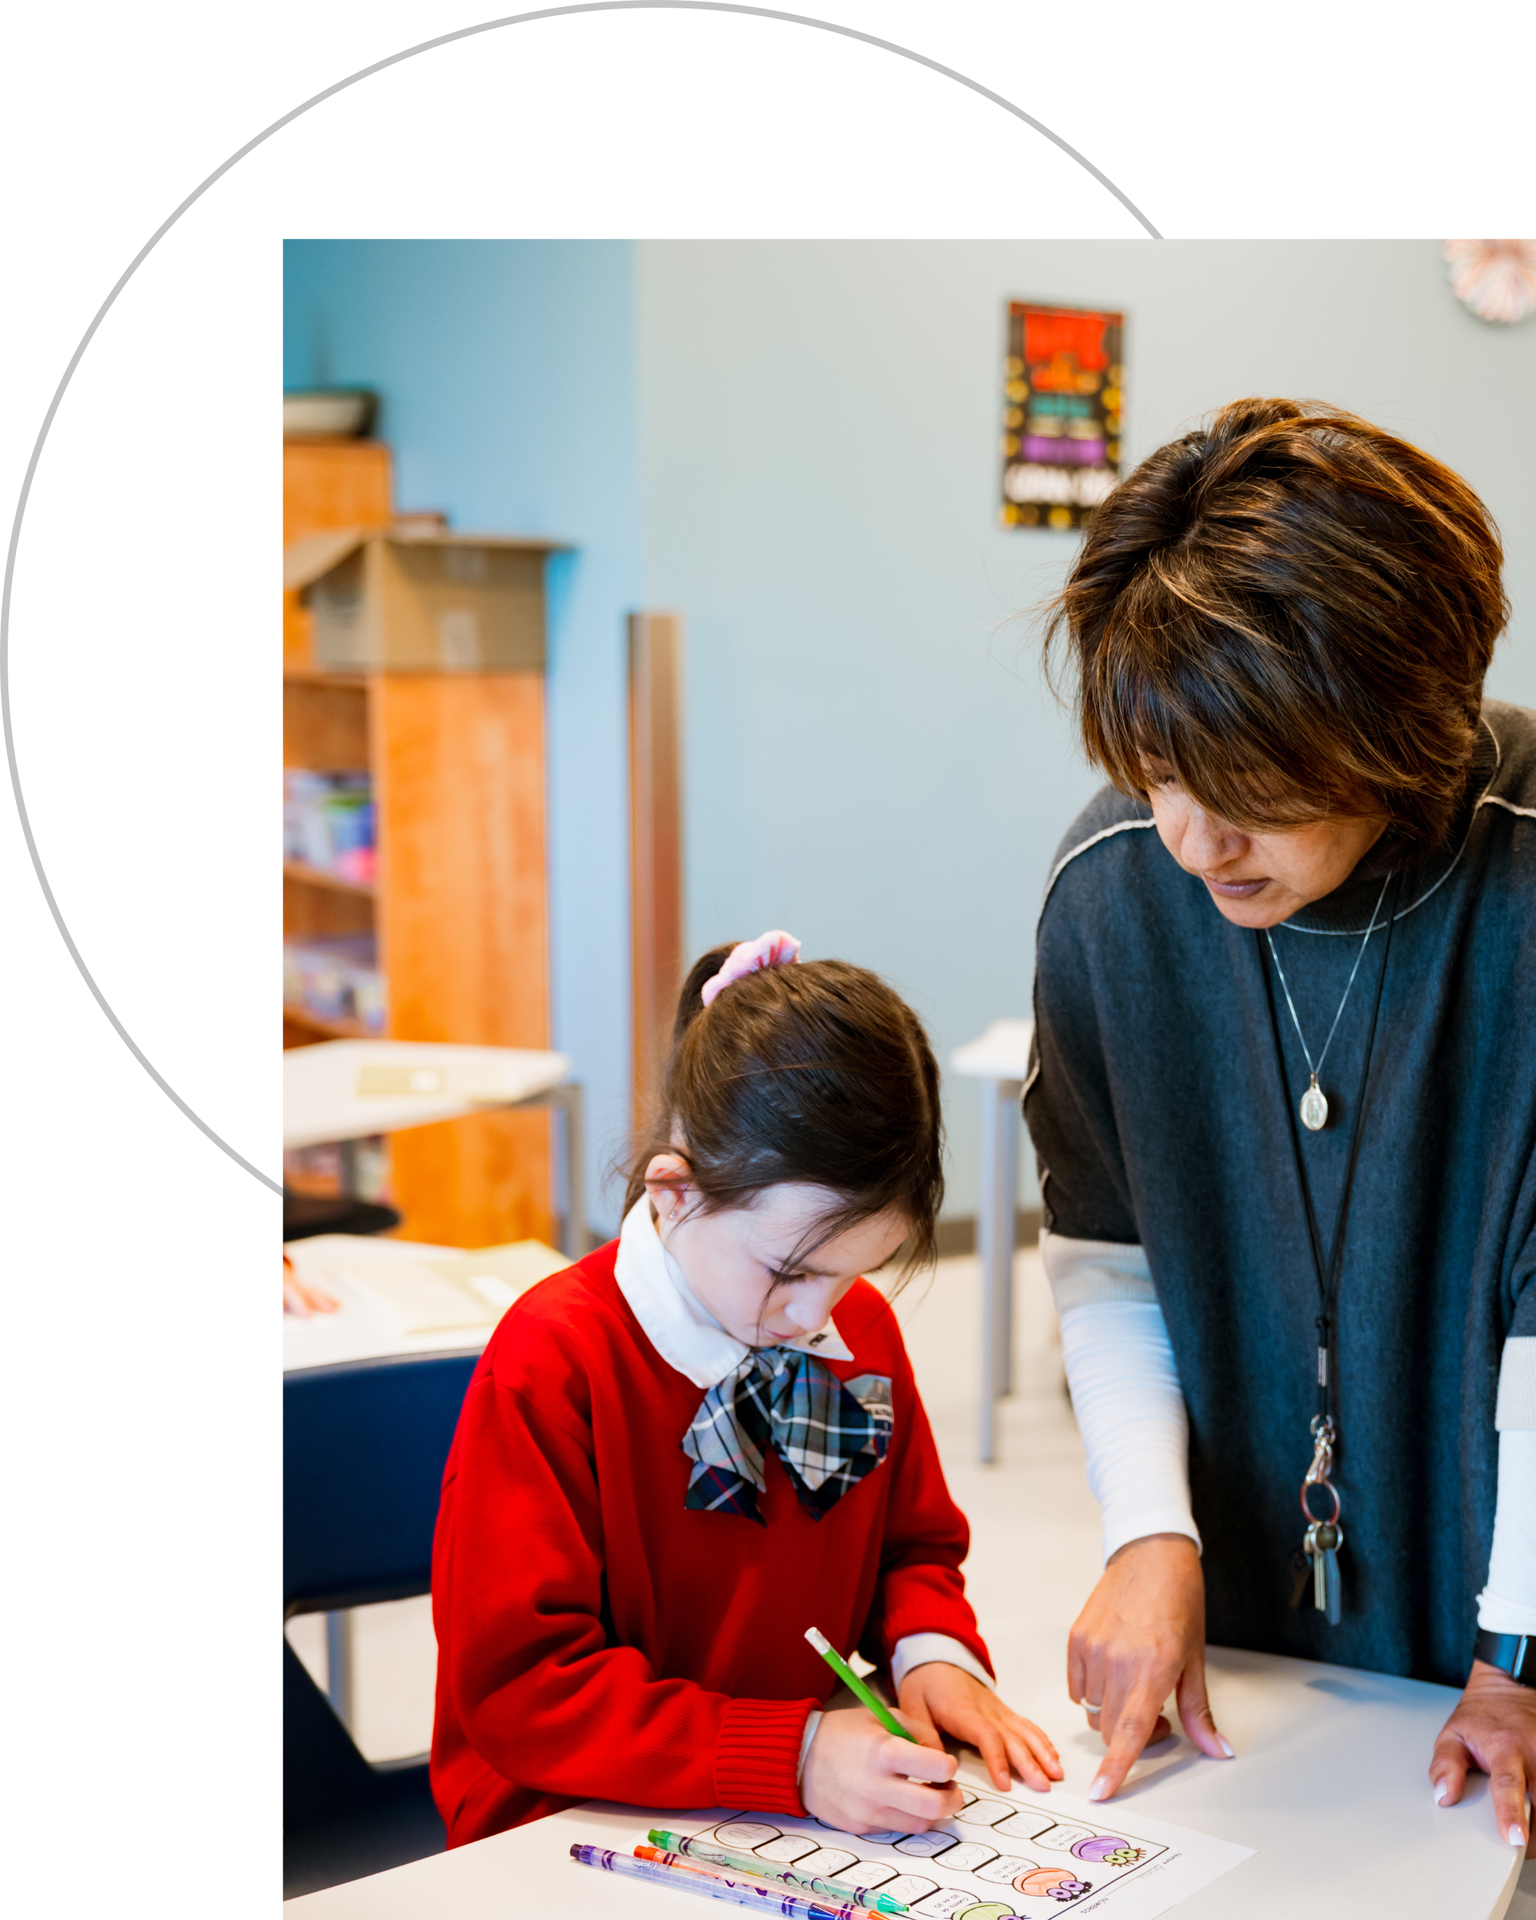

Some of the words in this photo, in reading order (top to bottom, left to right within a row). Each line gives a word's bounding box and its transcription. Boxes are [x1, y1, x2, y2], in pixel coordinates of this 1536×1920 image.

[1007, 1816, 1045, 1834] 10
[810, 1851, 845, 1870] 60
[946, 1845, 985, 1868] 60
[887, 1878, 926, 1897] 20
